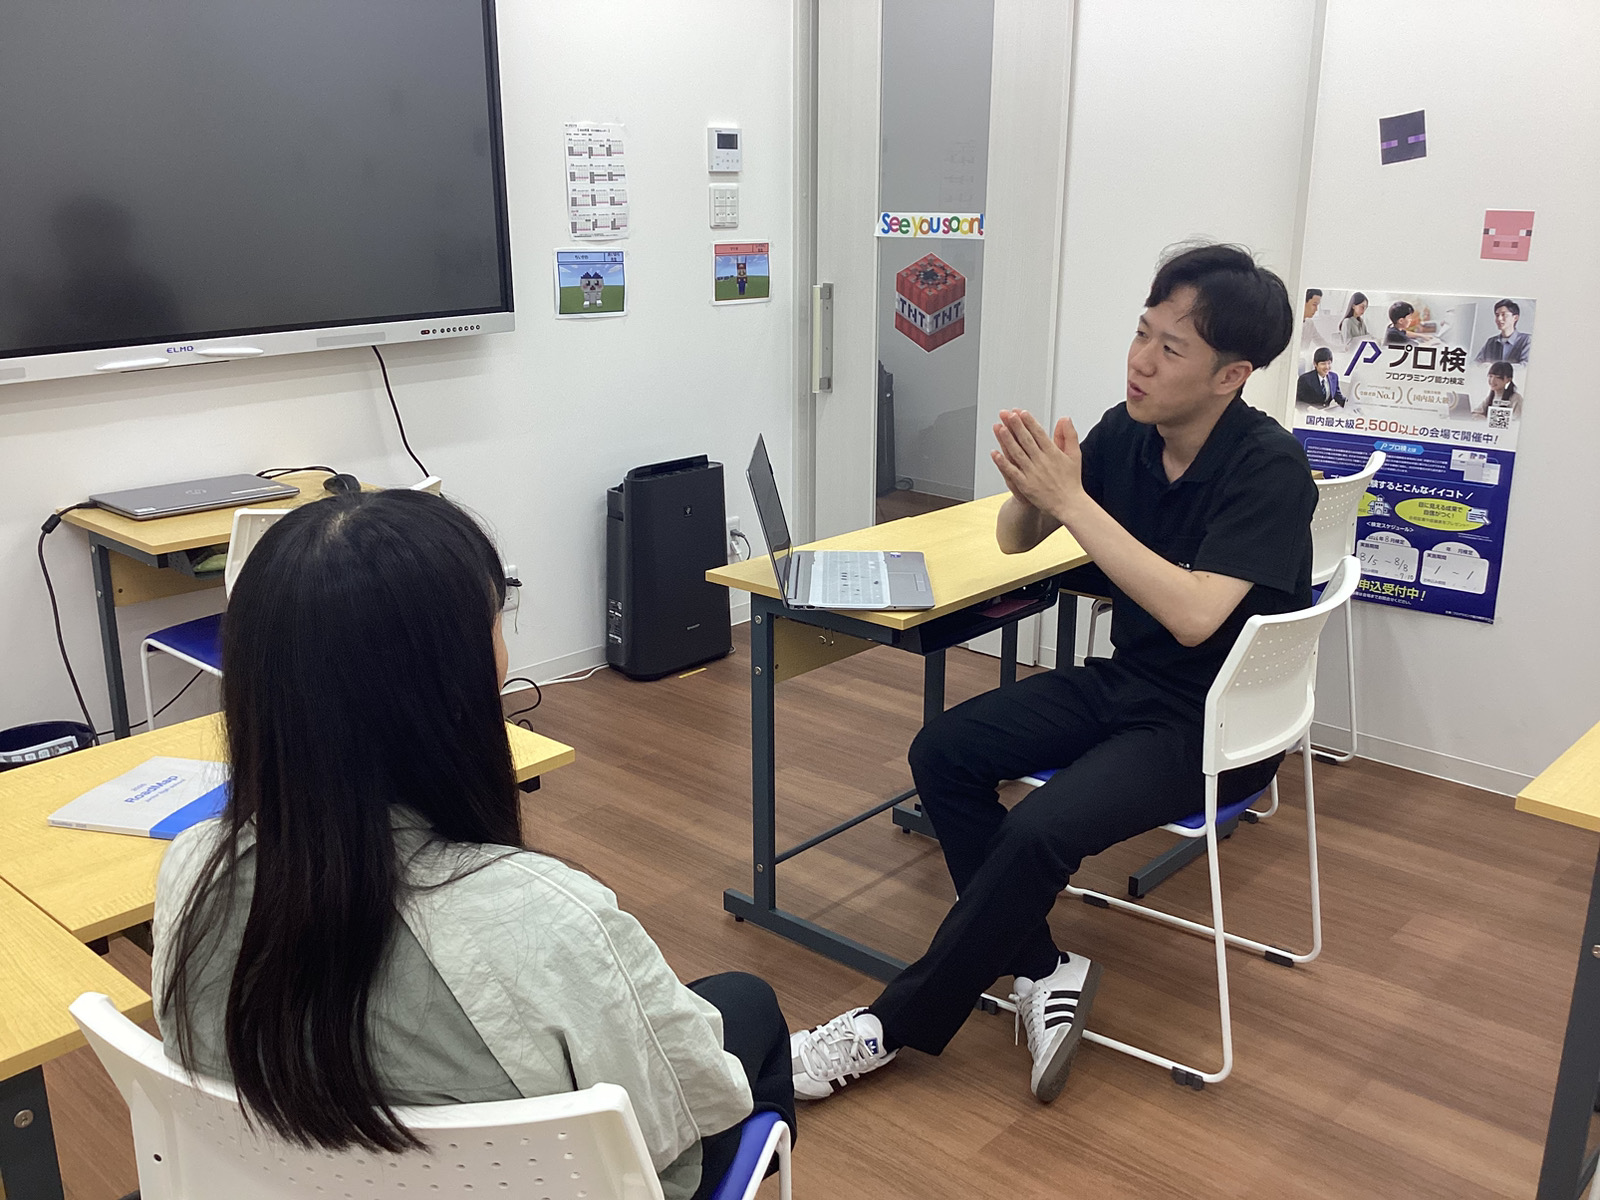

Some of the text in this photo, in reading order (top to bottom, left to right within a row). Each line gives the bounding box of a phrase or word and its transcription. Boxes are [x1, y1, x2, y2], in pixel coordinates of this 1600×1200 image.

[881, 213, 984, 238] See you soon!
[899, 297, 926, 328] TNT
[933, 301, 962, 329] TNT
[166, 345, 194, 354] ELMO
[1387, 344, 1468, 373] プロ検
[1369, 479, 1464, 499] 験するとこんなイイコト
